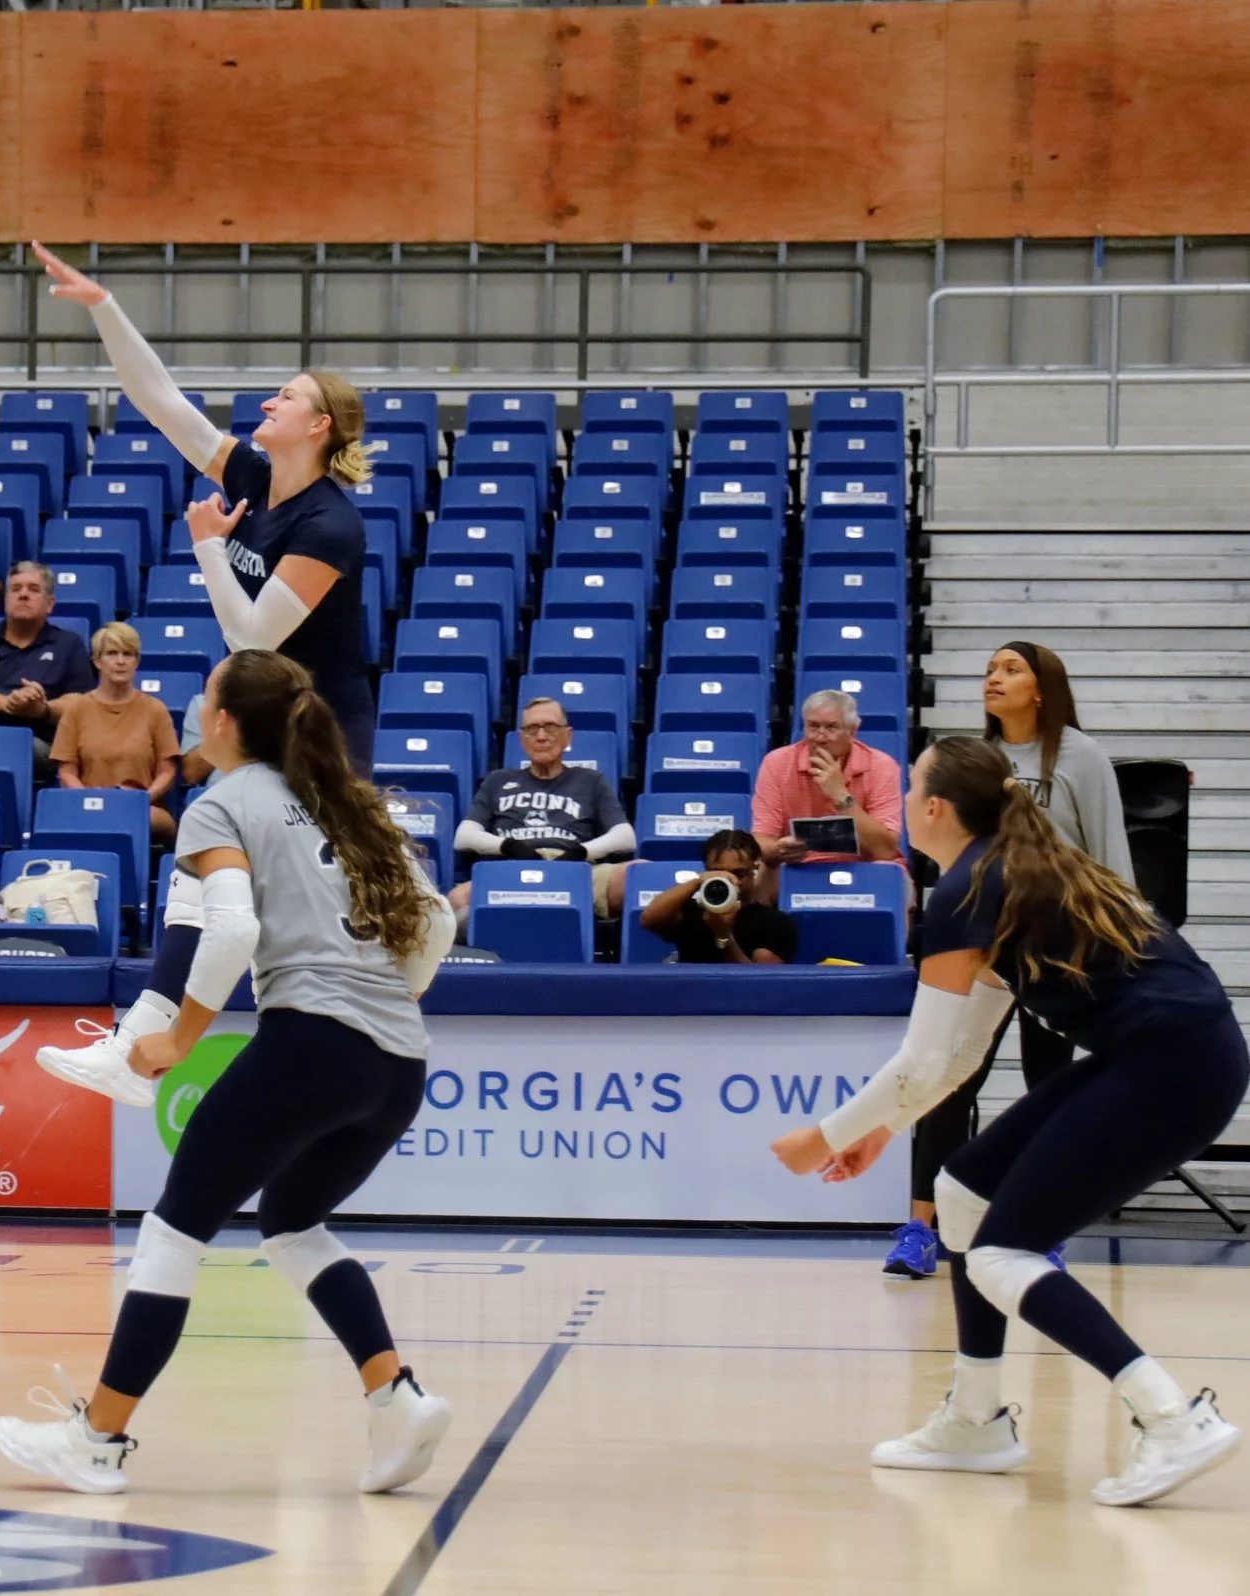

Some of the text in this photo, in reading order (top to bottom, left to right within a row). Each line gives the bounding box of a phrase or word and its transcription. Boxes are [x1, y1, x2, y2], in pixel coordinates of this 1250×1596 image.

[498, 791, 582, 819] UCONN
[425, 1069, 683, 1114] ORGIA'S
[395, 1128, 667, 1160] EDIT UNION
